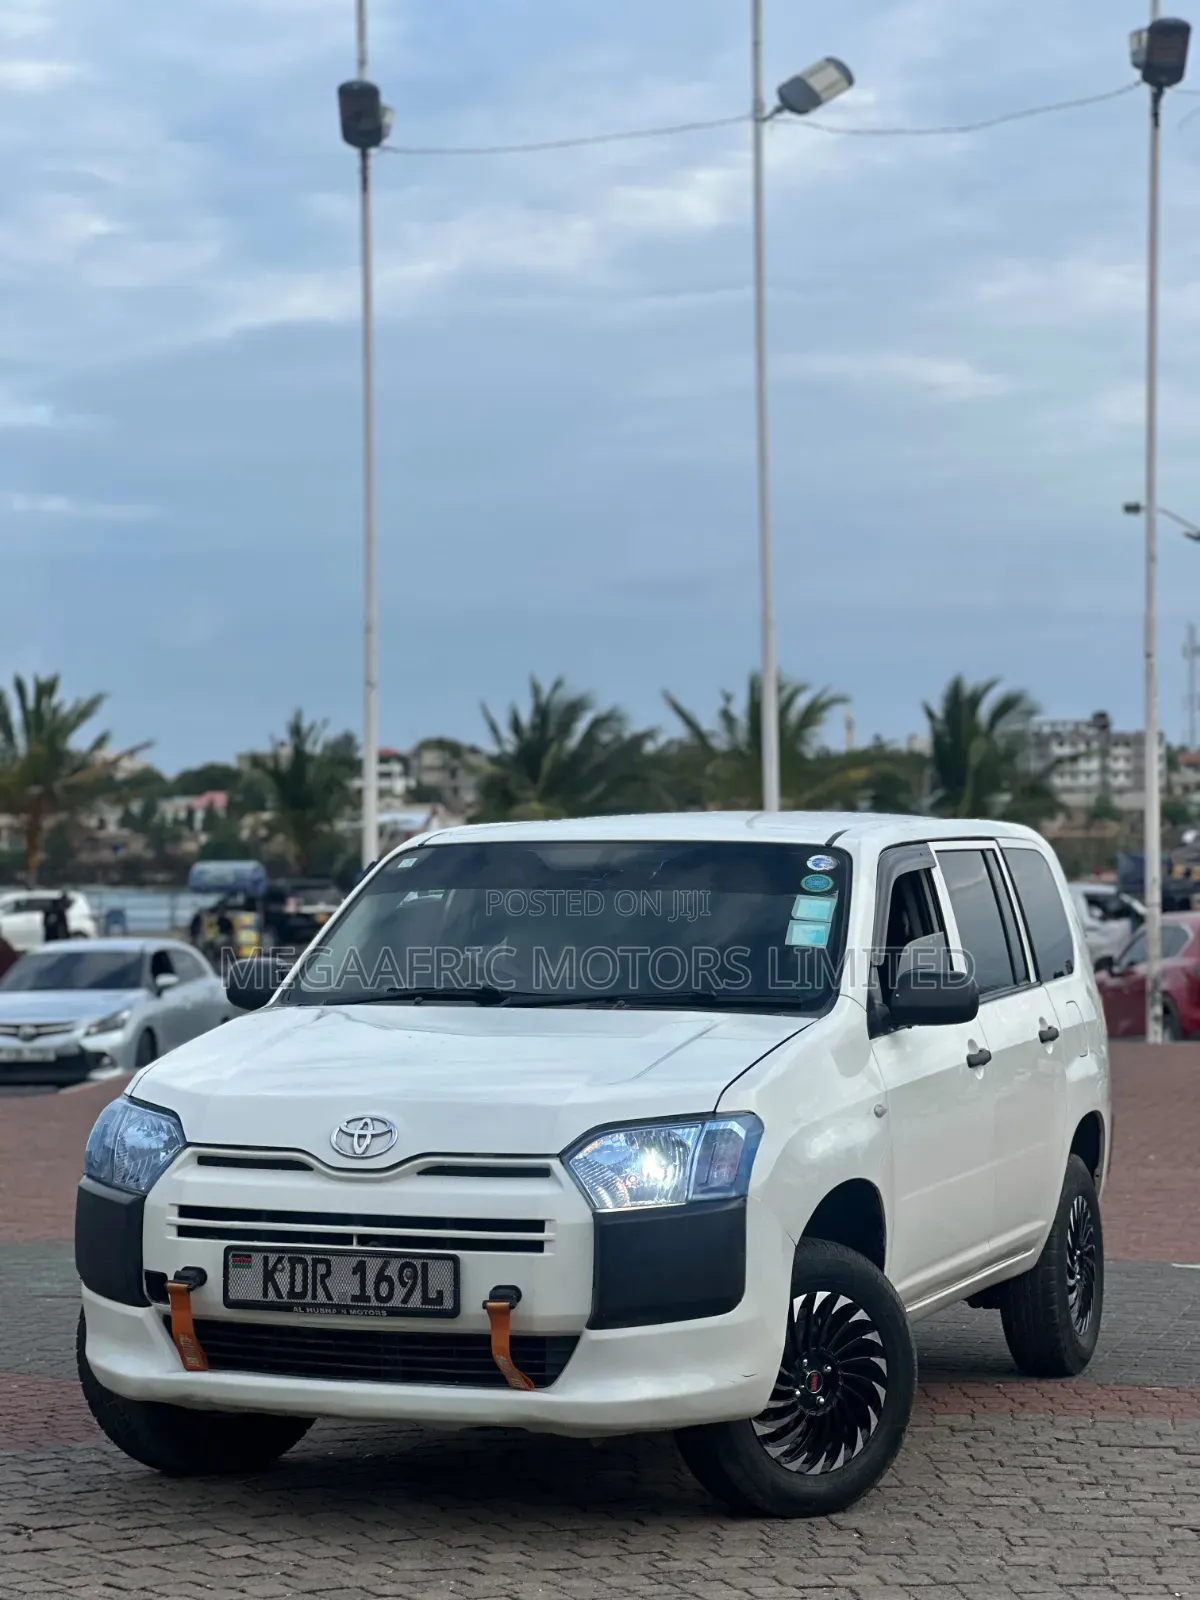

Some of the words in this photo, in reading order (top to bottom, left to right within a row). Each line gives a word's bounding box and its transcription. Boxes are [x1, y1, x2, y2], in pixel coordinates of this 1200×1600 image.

[262, 1255, 334, 1302] KDR
[350, 1259, 444, 1307] 169L
[349, 1309, 388, 1317] MOTORS
